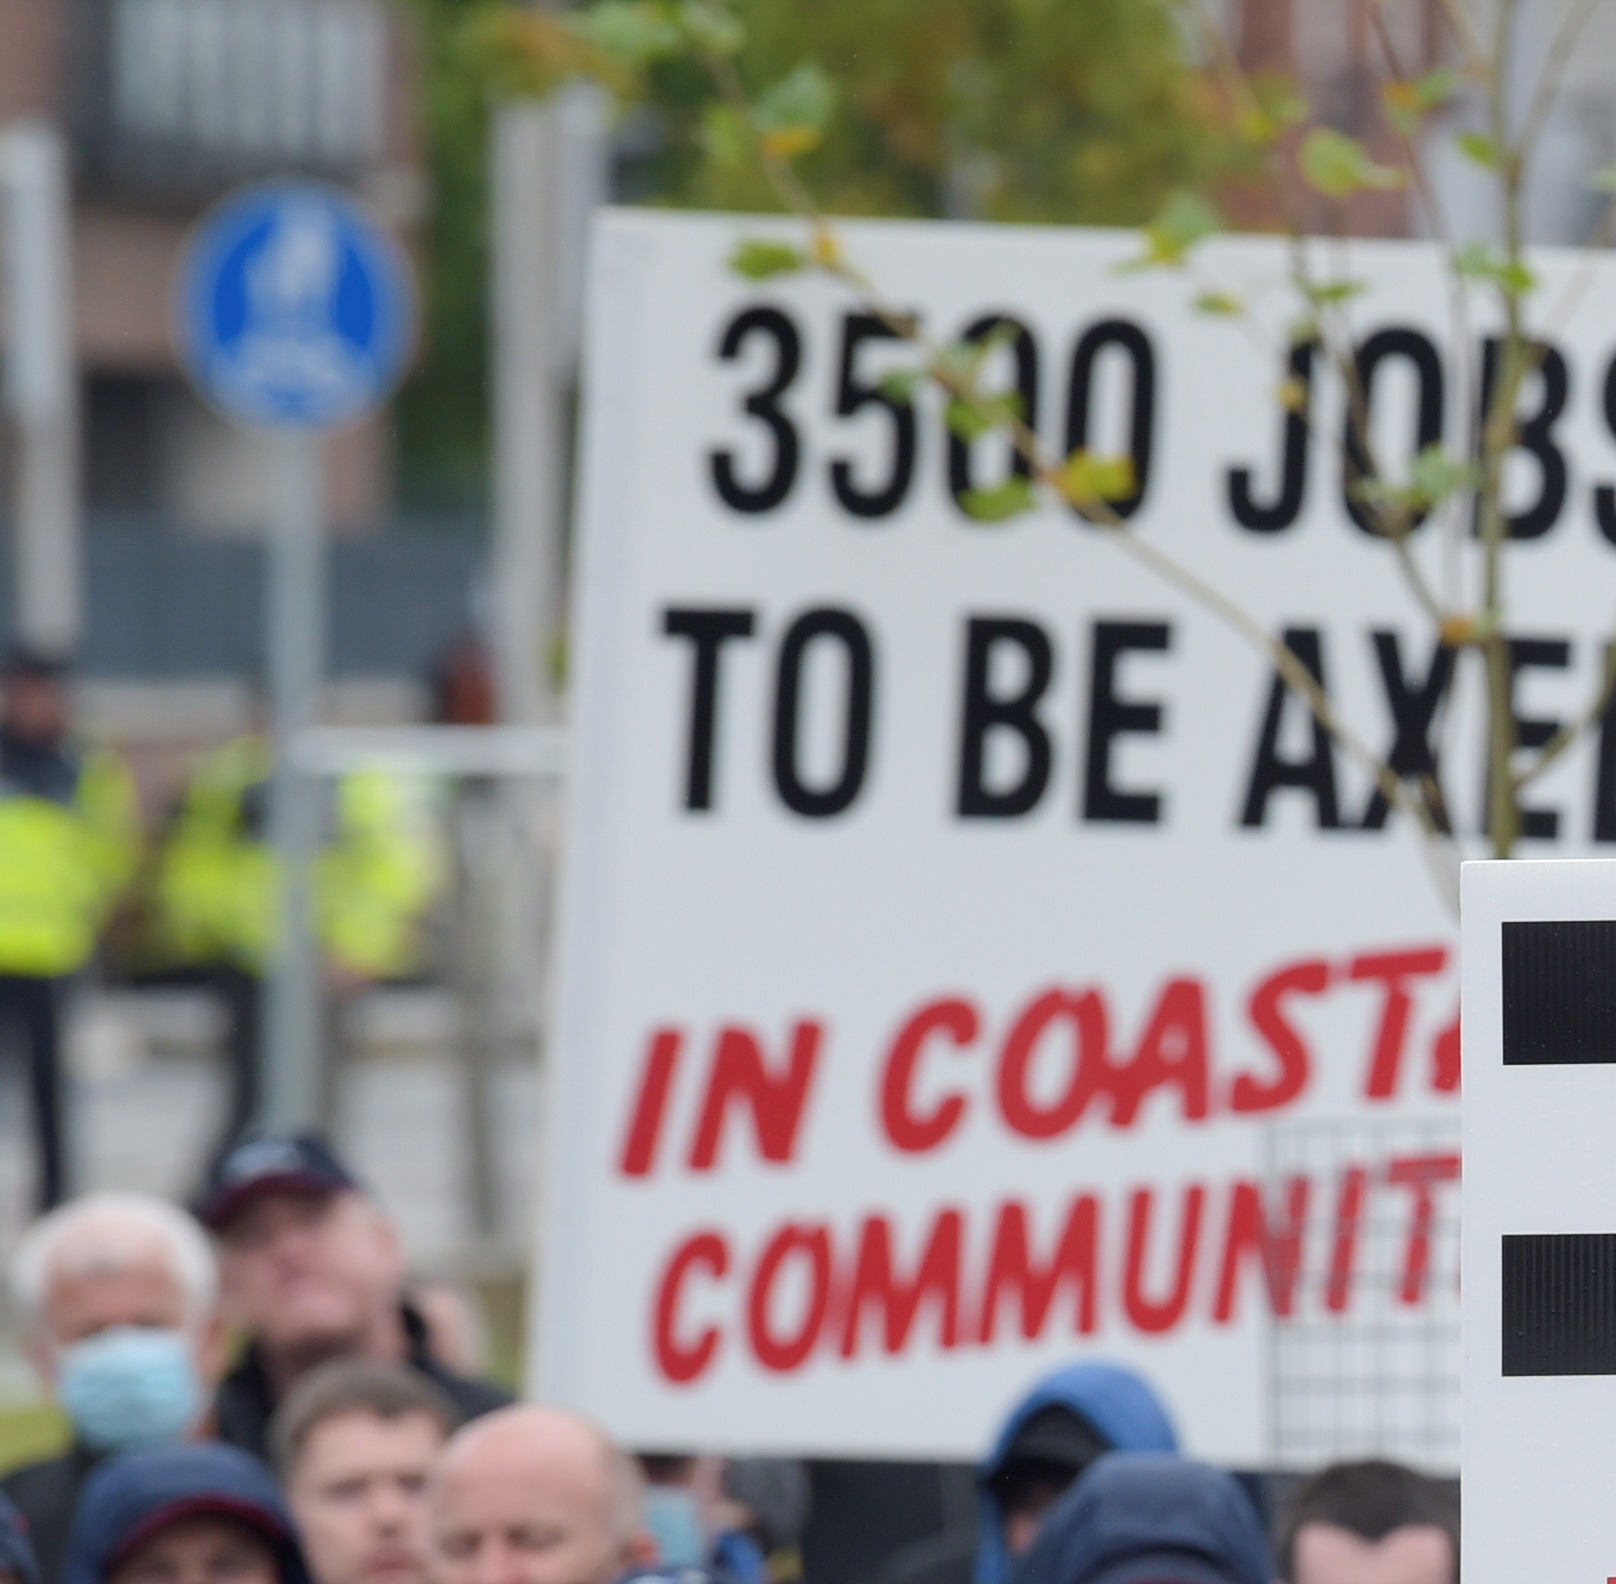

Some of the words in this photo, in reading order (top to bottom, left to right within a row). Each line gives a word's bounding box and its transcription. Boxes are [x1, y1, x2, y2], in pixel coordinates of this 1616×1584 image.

[708, 305, 1158, 524] 3500
[660, 606, 877, 820] TO
[953, 614, 1174, 824] BE
[617, 1018, 825, 1180] IN
[875, 945, 1461, 1156] COAST
[648, 1153, 1460, 1388] COMMUNIT
